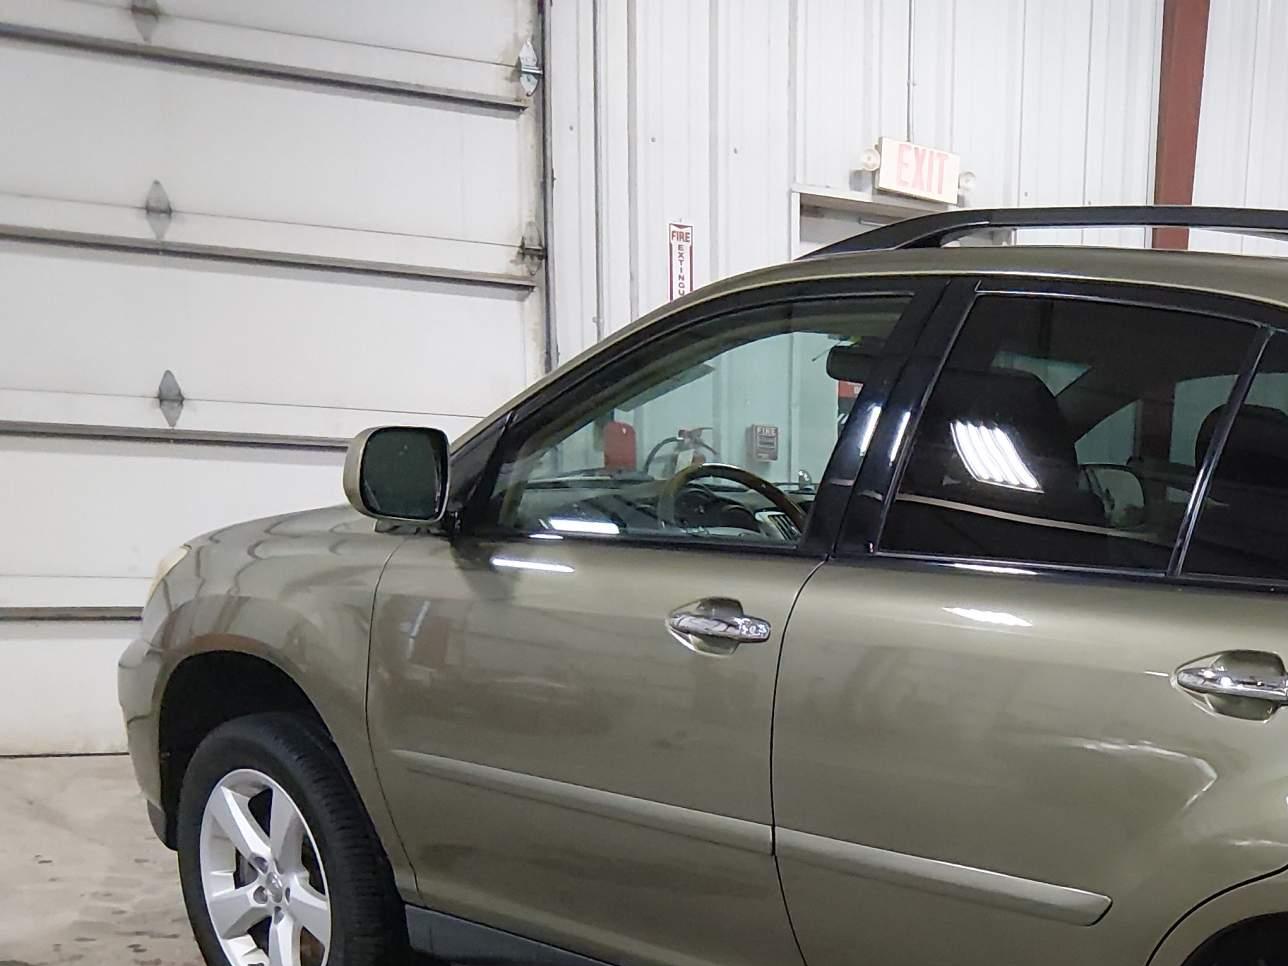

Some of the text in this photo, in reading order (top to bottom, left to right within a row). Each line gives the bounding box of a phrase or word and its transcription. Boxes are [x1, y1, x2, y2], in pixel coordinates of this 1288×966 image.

[896, 143, 949, 195] EXIT
[671, 230, 691, 243] FIRE
[677, 244, 686, 296] EXTINGU
